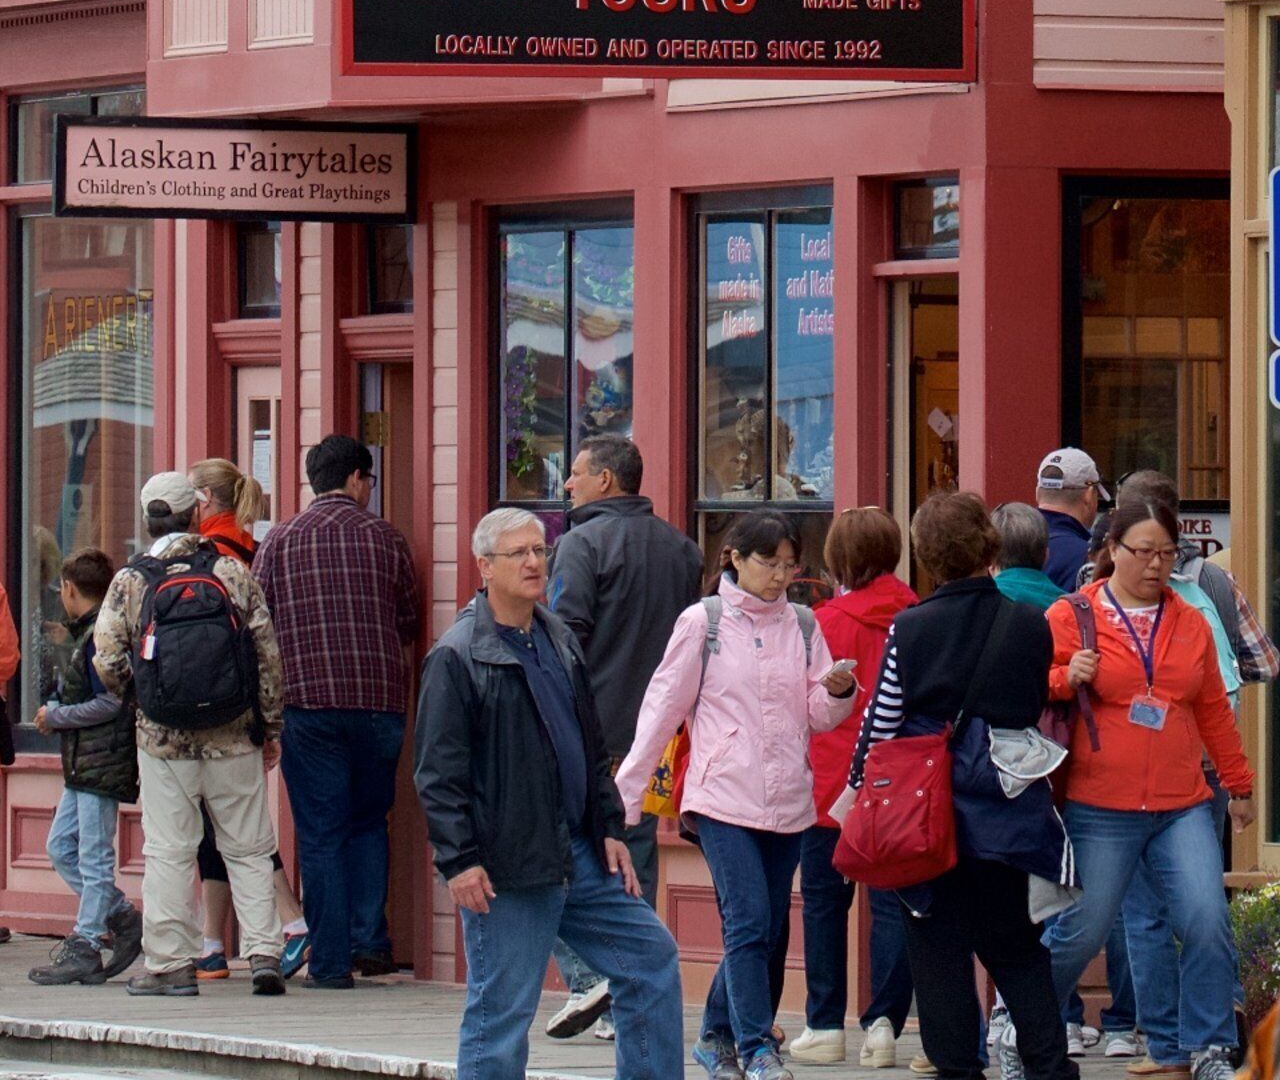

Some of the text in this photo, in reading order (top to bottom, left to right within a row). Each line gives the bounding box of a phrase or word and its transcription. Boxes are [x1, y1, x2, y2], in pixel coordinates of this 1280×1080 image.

[435, 34, 882, 60] LOCALLY OWNED AND OPERATED SINCE 1992
[80, 138, 394, 179] Alaskan Fairytales
[78, 178, 391, 203] Children's Clothing and Great Playthings
[801, 231, 831, 261] Local
[719, 272, 747, 301] made
[786, 270, 807, 299] and
